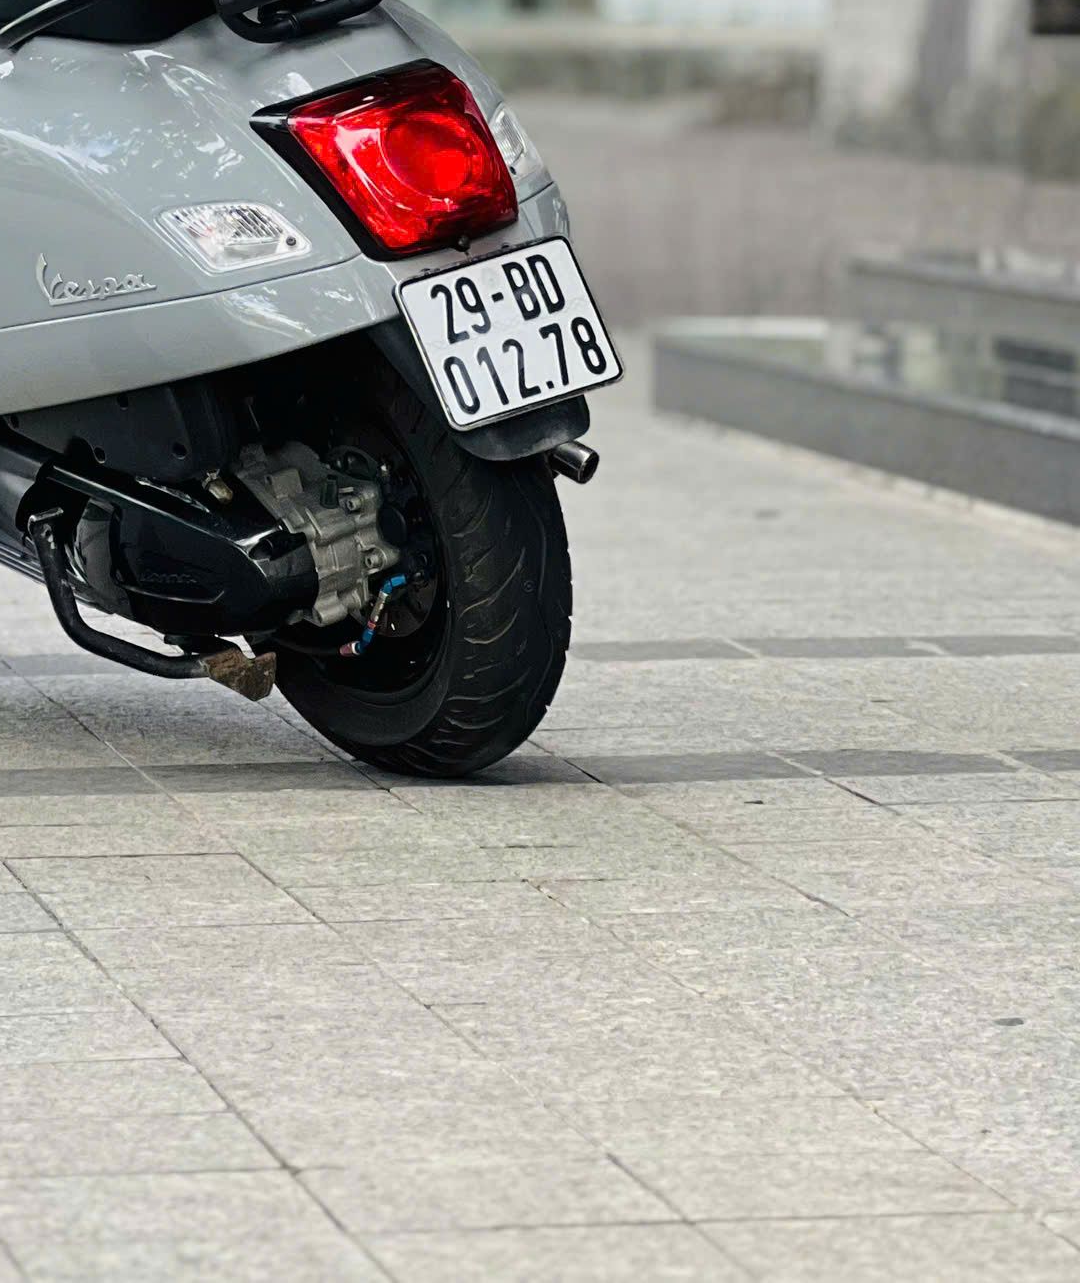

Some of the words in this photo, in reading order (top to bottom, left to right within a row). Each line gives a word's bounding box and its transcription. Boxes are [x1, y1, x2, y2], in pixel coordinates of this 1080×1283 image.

[35, 252, 157, 306] Vespa
[430, 254, 565, 344] 29-BD
[443, 317, 607, 415] 012.78
